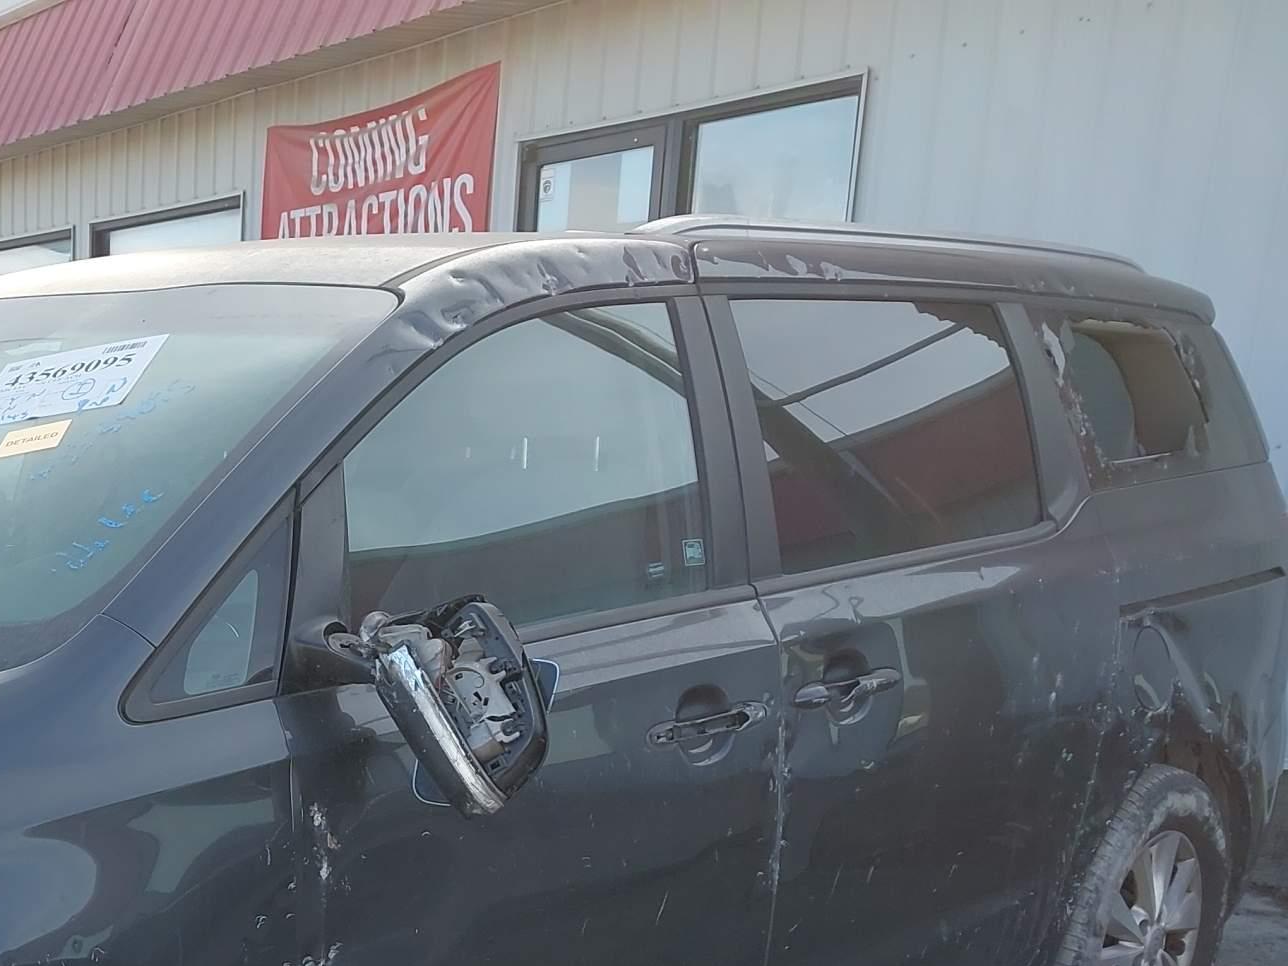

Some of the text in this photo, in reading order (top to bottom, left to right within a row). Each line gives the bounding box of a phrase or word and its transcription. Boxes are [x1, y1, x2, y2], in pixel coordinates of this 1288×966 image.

[310, 107, 429, 195] COMING
[278, 173, 474, 240] ATTRACTIONS
[5, 352, 137, 387] 43569095
[5, 431, 59, 447] DETAILED
